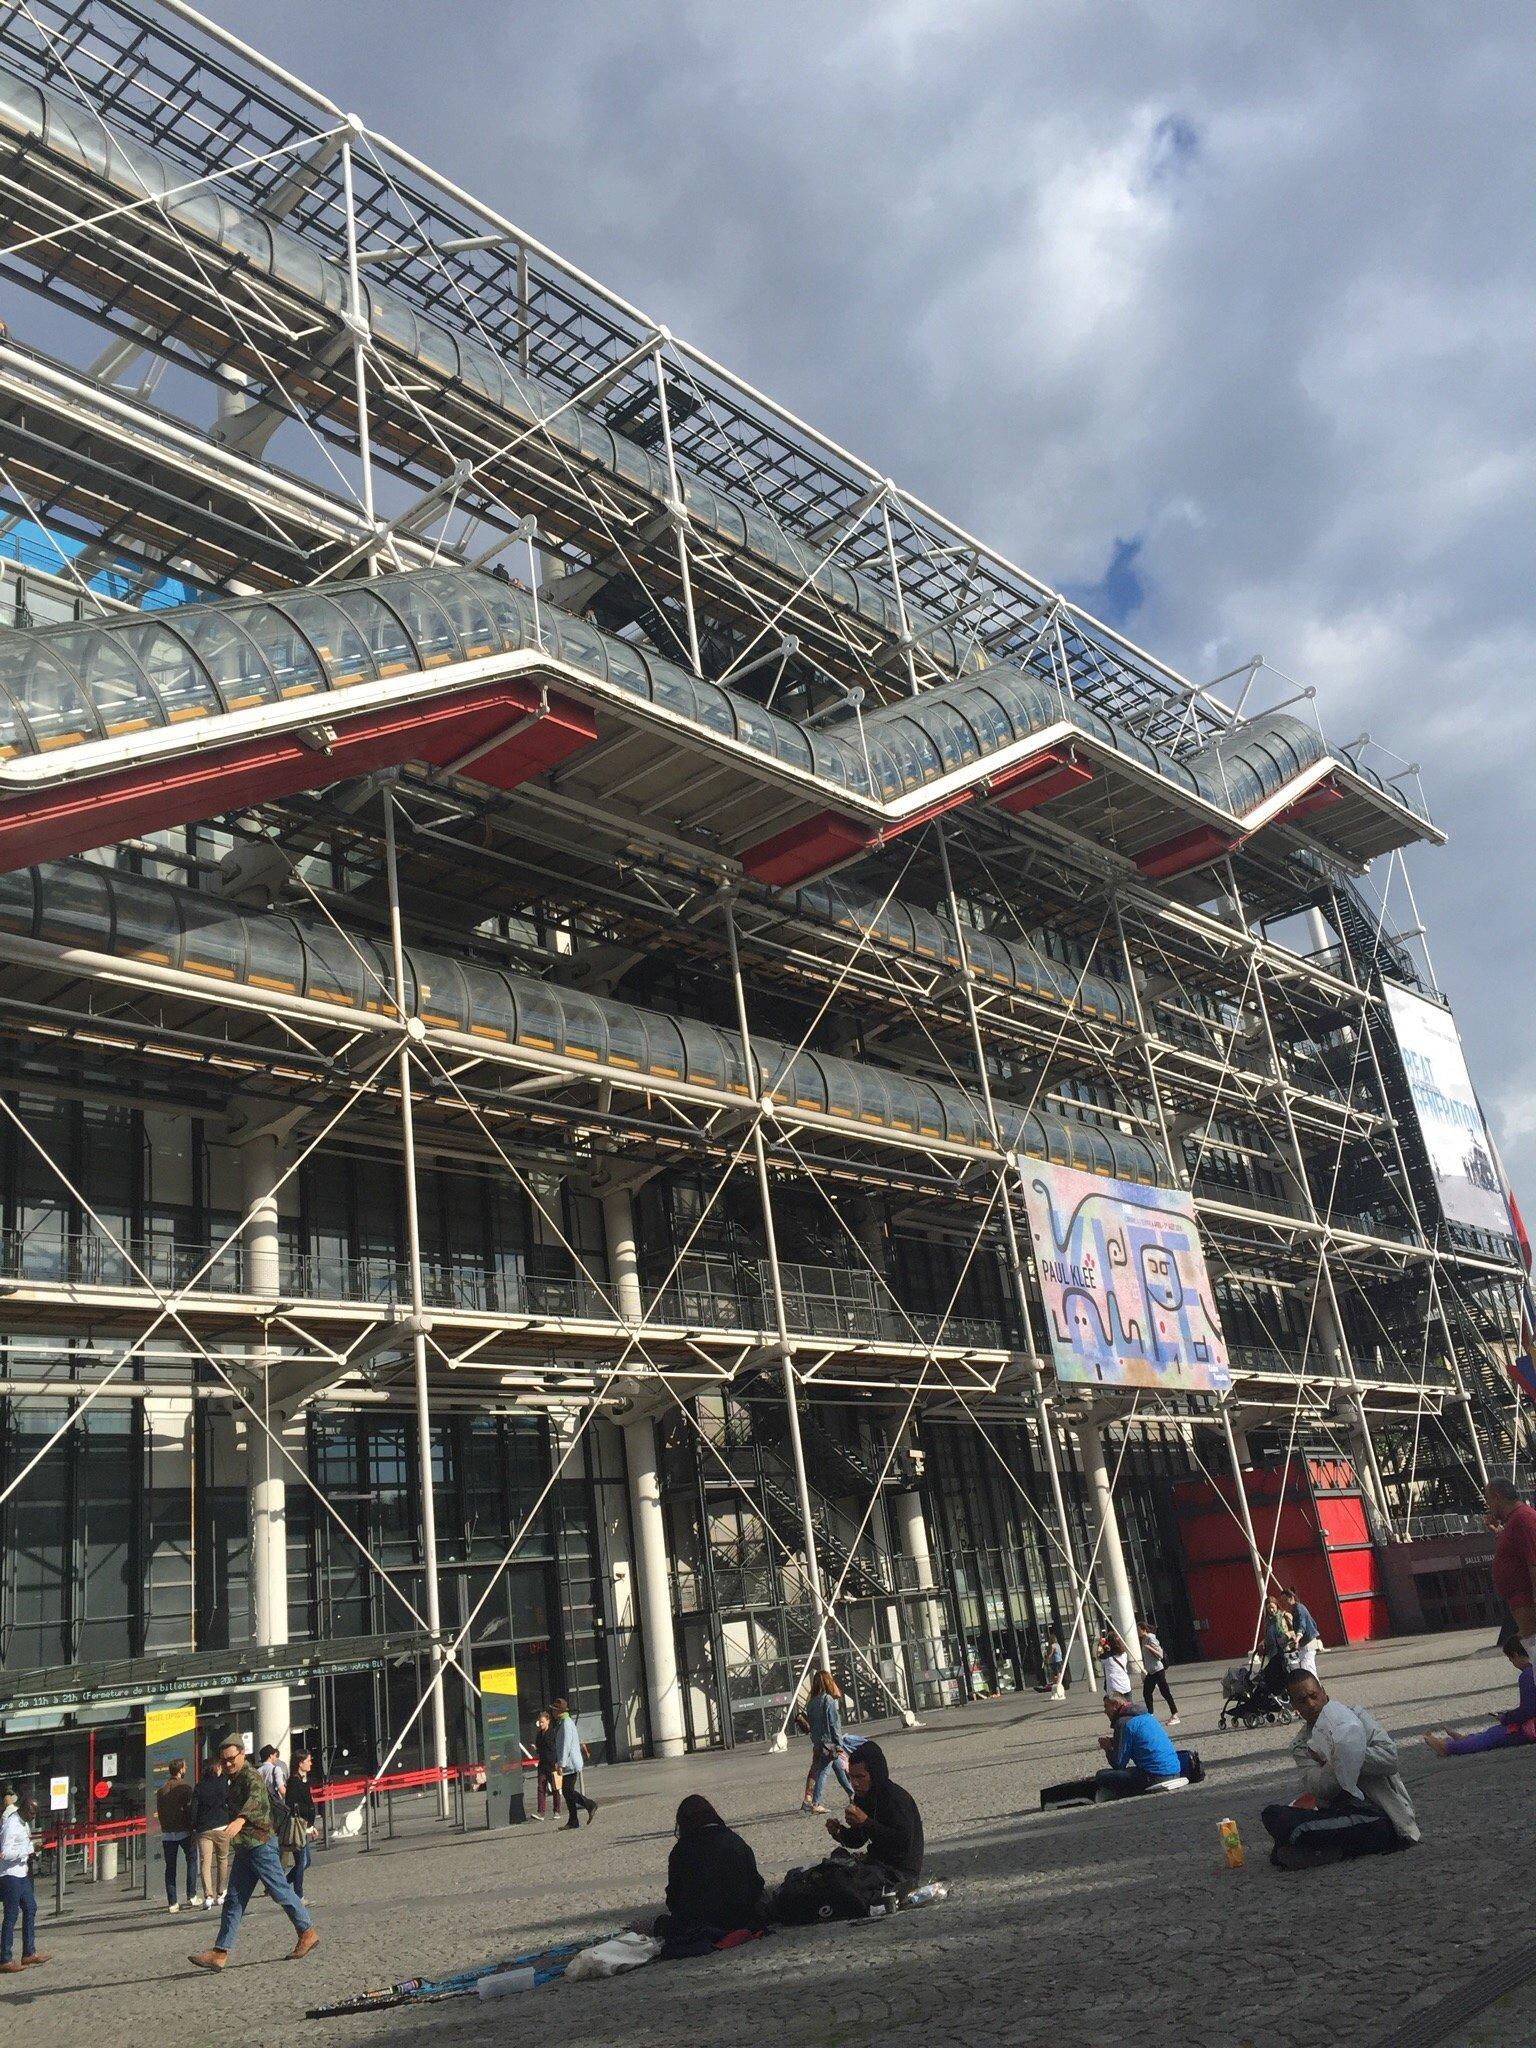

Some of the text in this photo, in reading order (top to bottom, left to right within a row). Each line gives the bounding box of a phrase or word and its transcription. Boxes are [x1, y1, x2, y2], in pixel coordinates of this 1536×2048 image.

[1041, 1259, 1097, 1289] PAUL KLEE
[18, 1699, 29, 1708] de
[33, 1697, 49, 1706] 11h
[52, 1696, 59, 1704] à
[62, 1694, 78, 1703] 21h
[82, 1690, 129, 1700] (Fermeture
[133, 1686, 142, 1694] de
[147, 1685, 156, 1693] la
[160, 1680, 208, 1691] billetterie
[211, 1678, 217, 1686] à
[220, 1676, 238, 1685] 20h)
[241, 1673, 258, 1682] sauf
[285, 1670, 294, 1678] et
[298, 1669, 309, 1677] 1er
